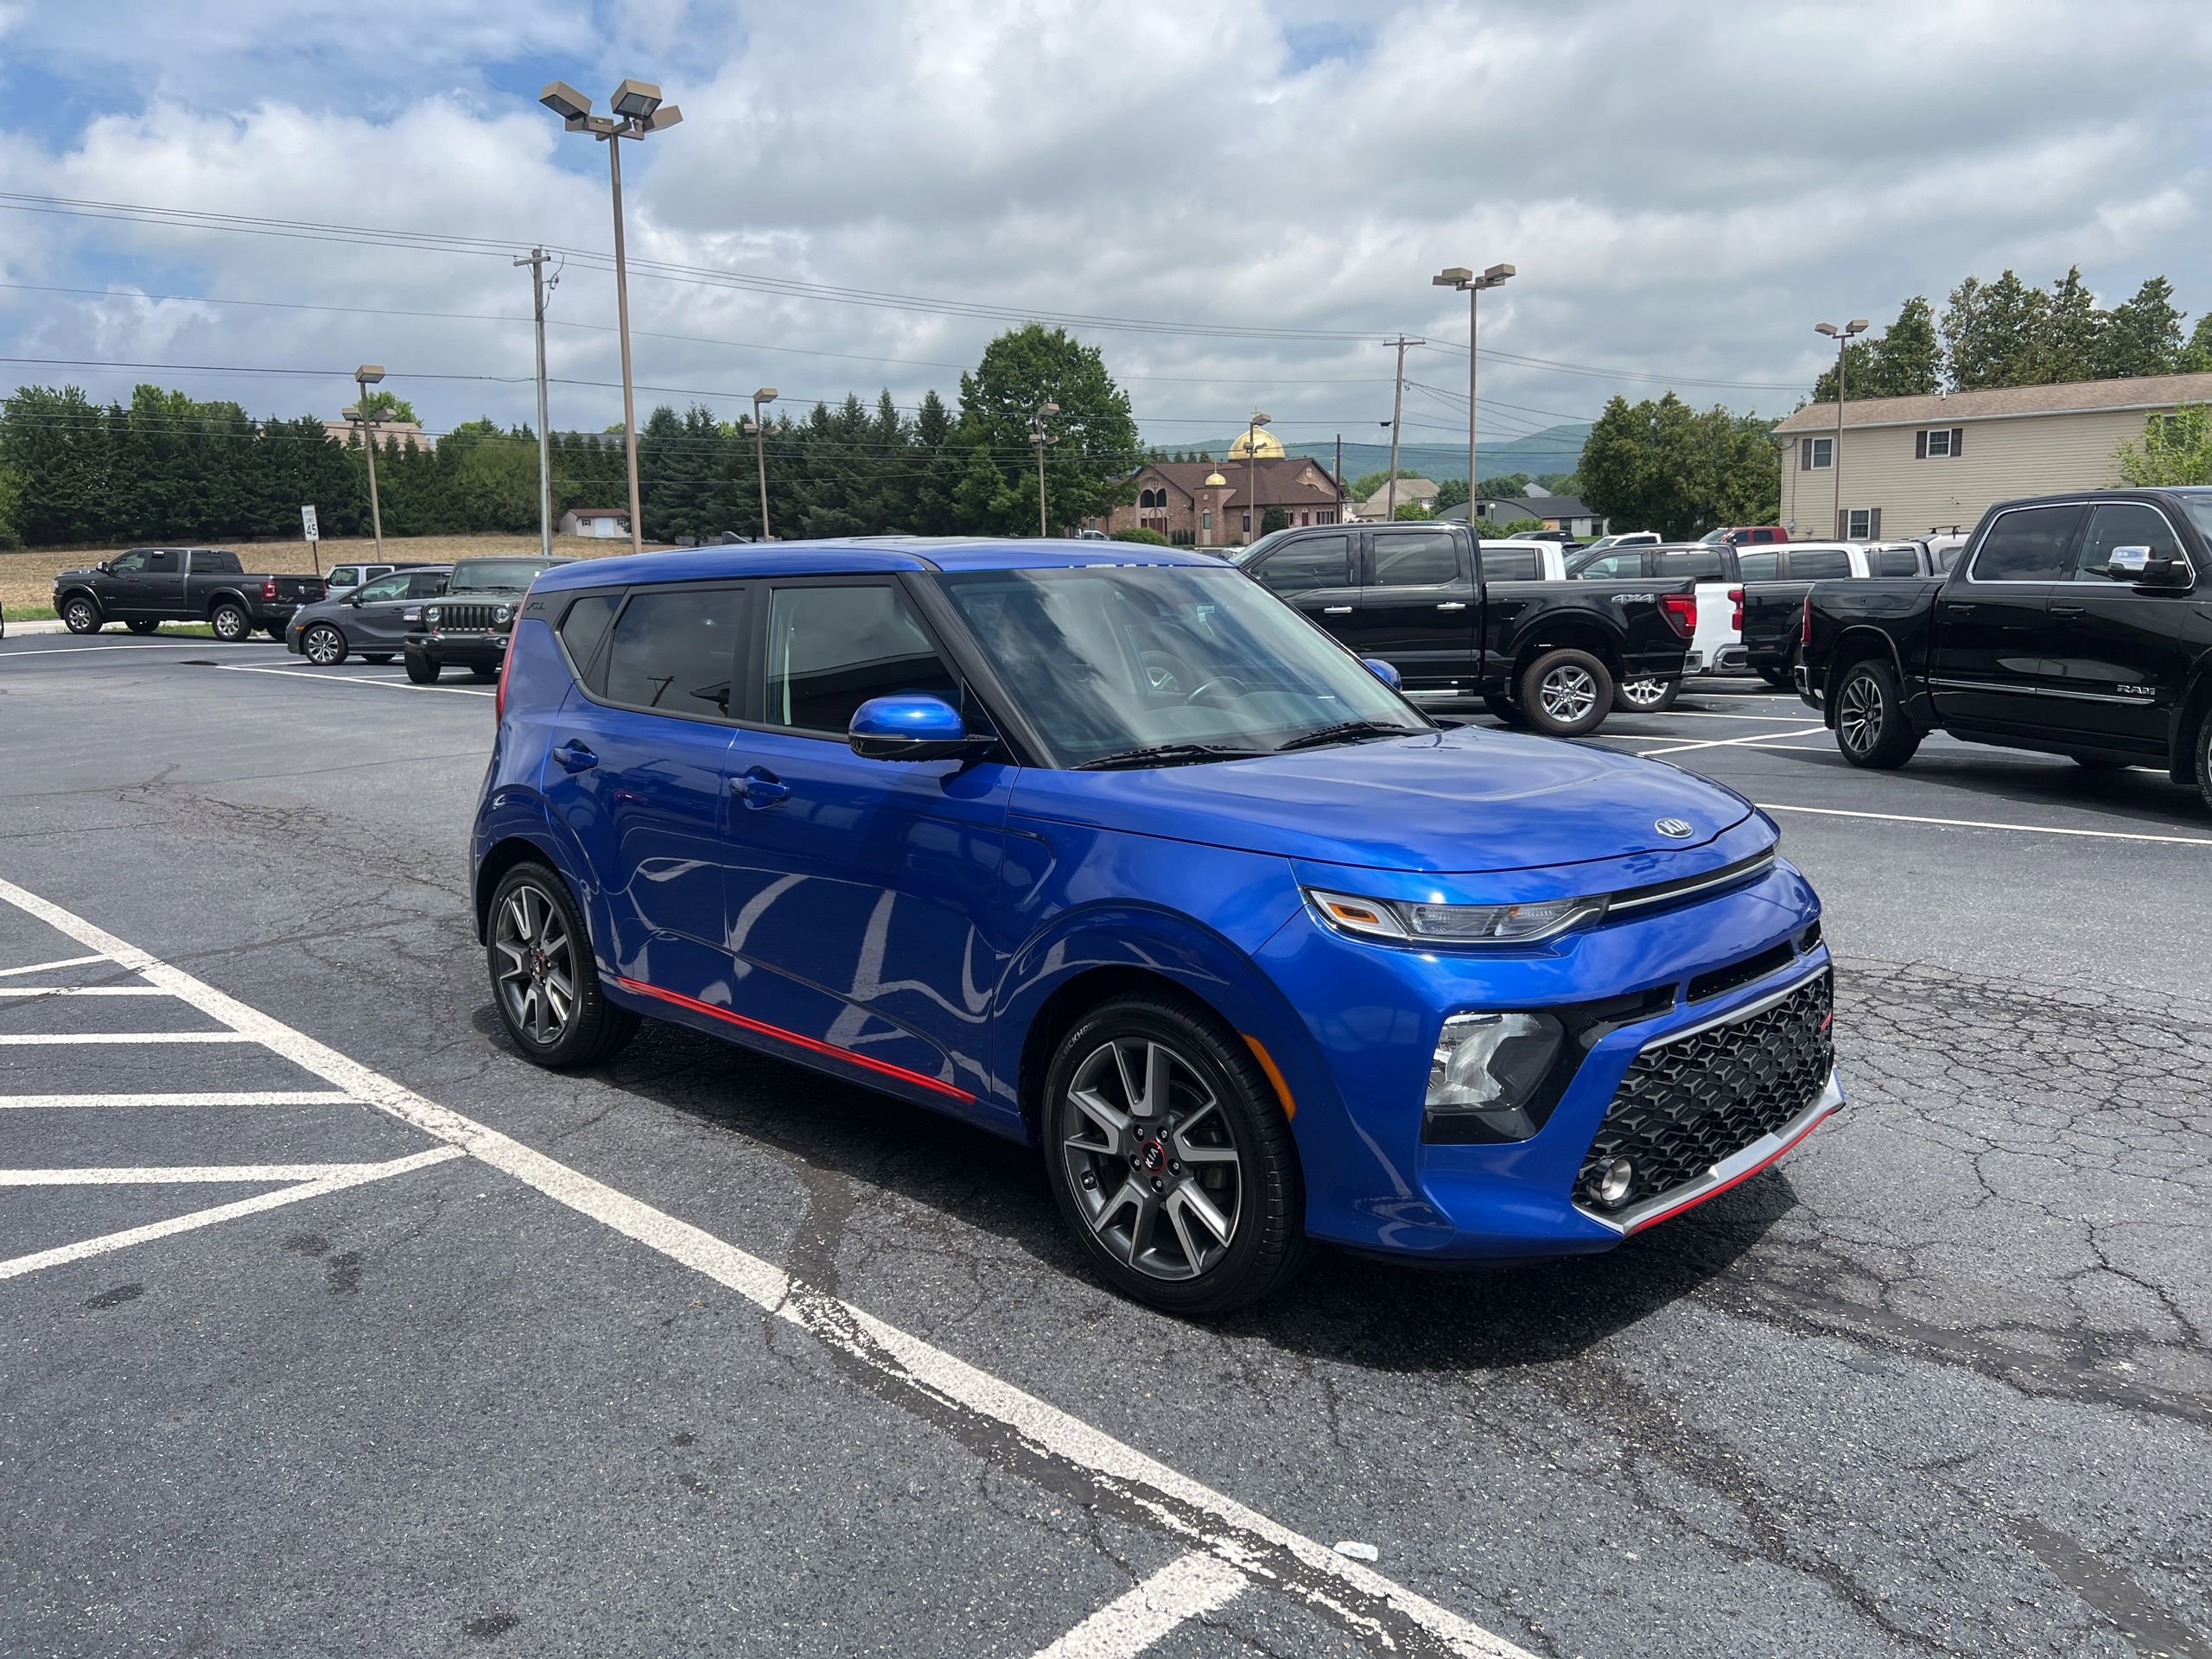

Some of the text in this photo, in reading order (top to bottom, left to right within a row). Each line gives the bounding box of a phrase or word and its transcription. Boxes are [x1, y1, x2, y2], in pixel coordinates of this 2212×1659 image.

[307, 524, 316, 536] 45
[2117, 684, 2156, 695] RAM
[1145, 1147, 1159, 1168] KIA
